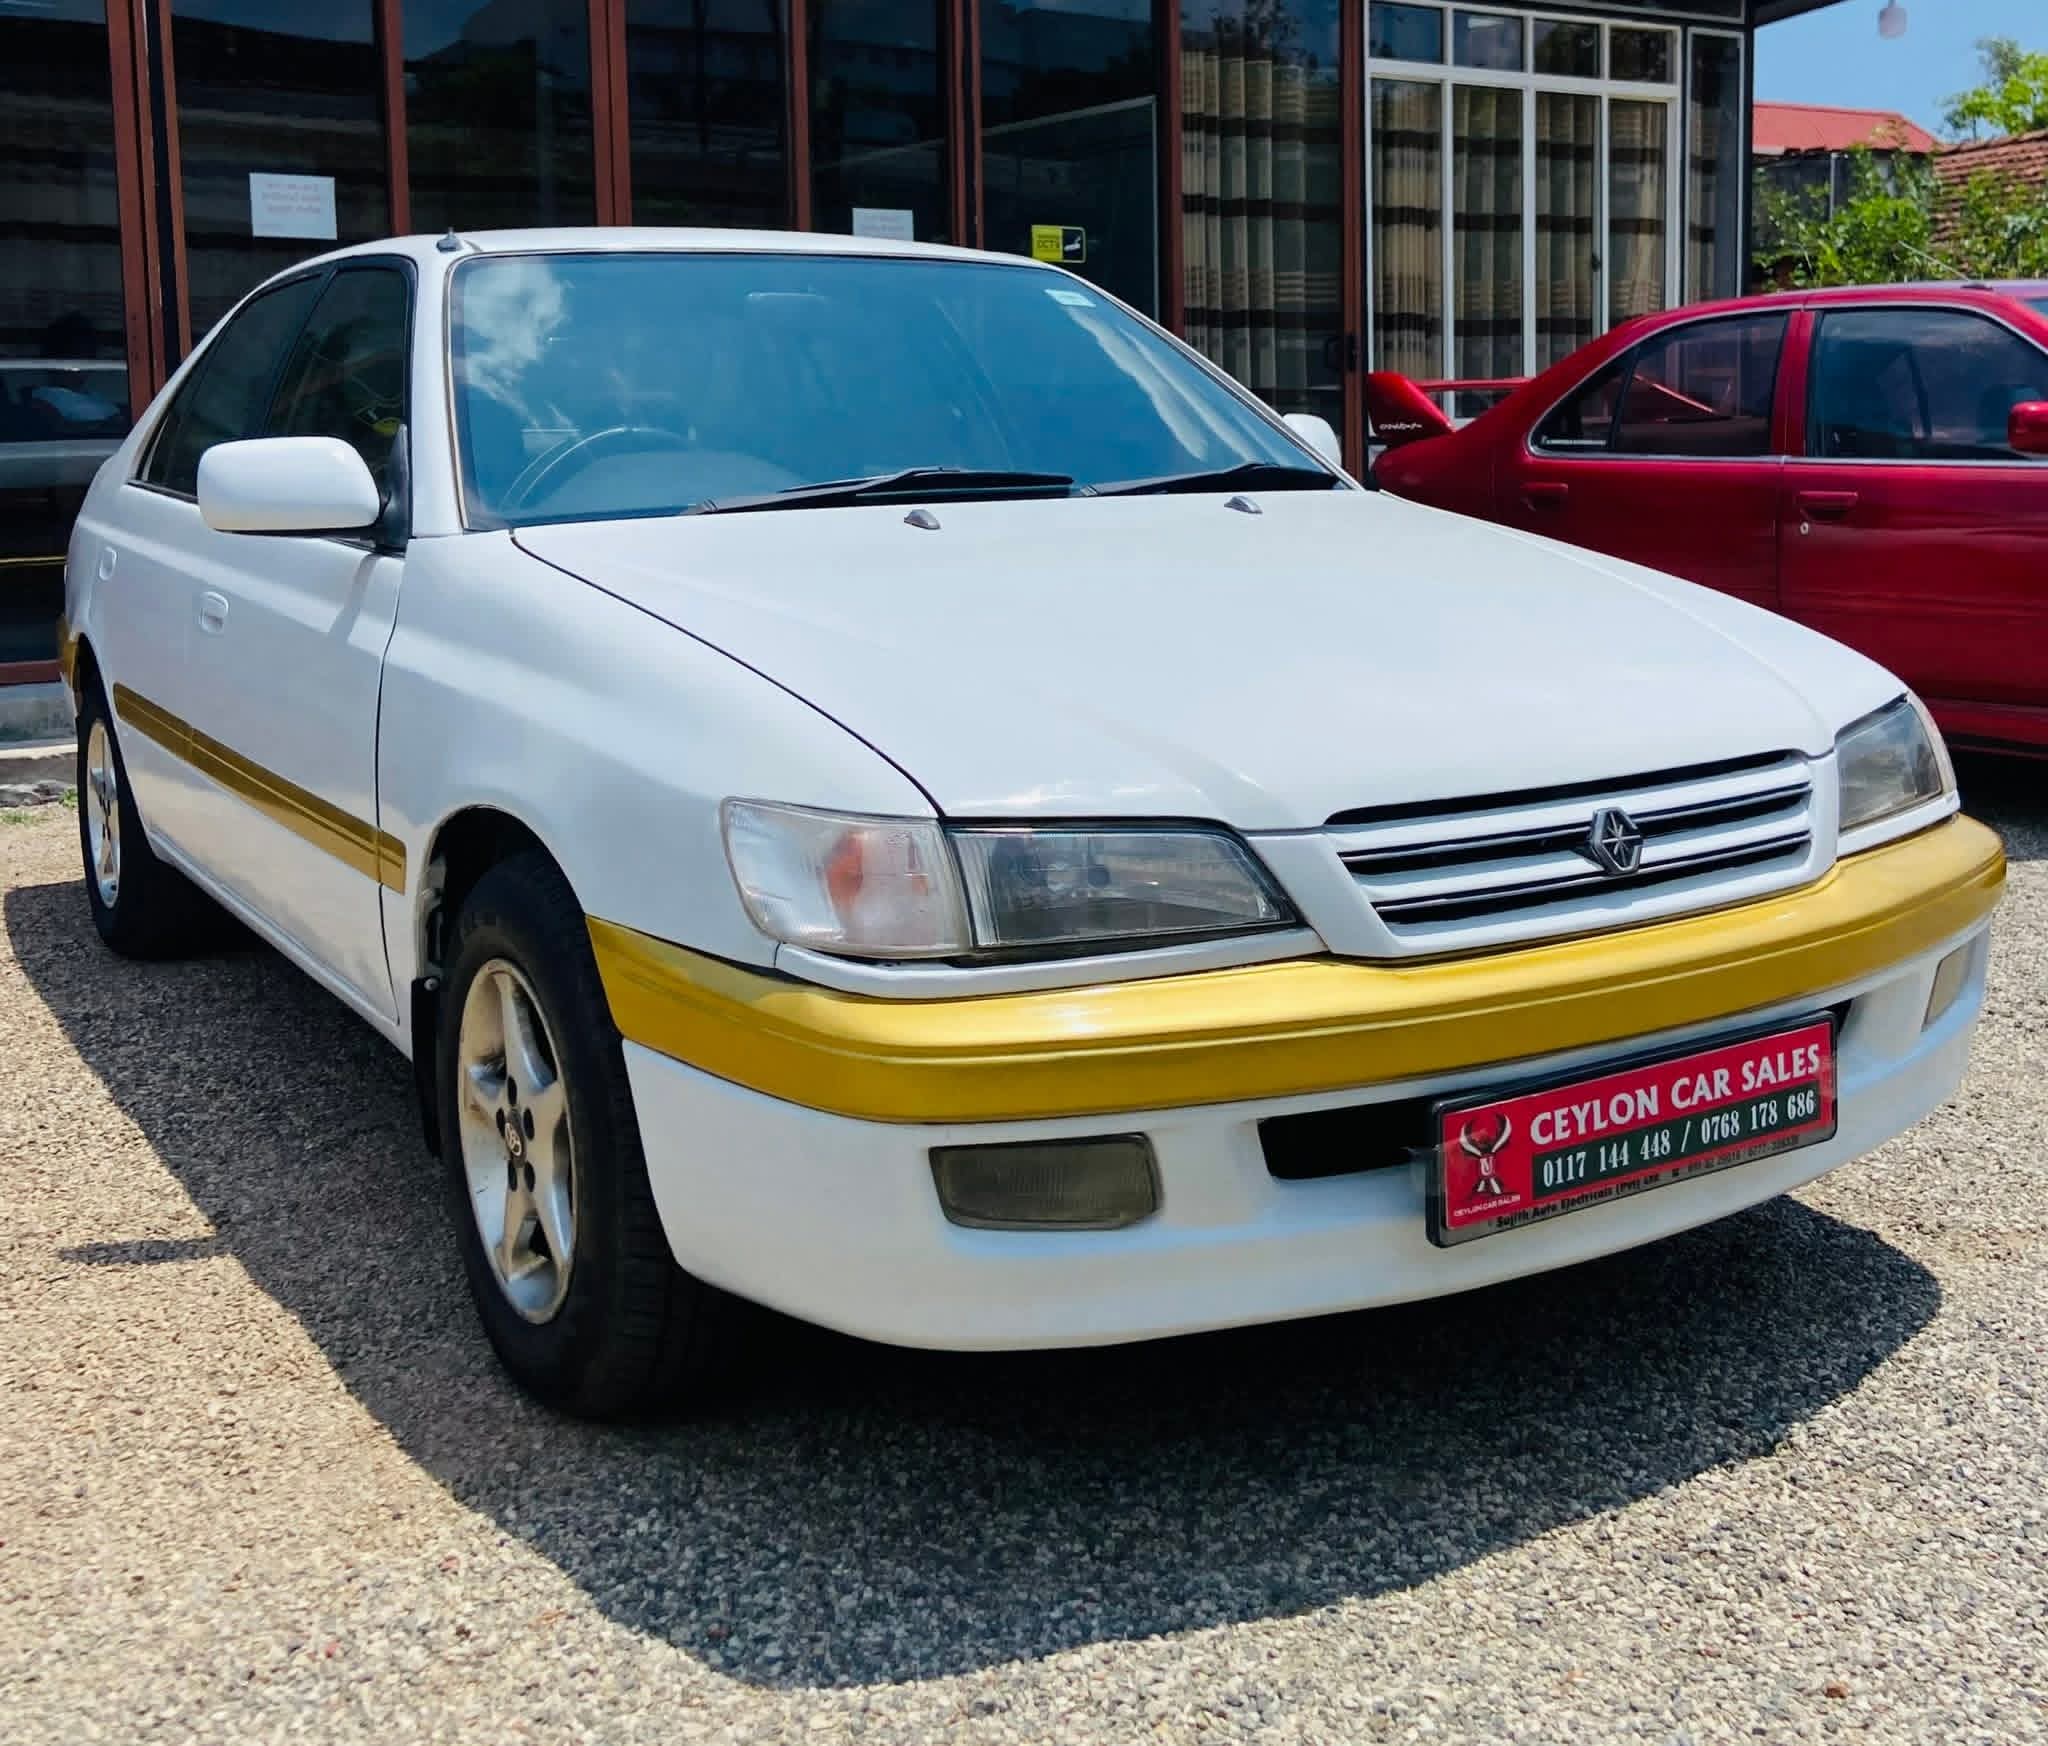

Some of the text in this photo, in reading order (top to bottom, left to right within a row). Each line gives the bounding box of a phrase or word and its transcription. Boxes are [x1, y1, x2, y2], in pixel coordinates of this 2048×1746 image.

[1530, 1043, 1820, 1144] CEYLON CAR SALES
[1542, 1151, 1587, 1187] 0117
[1599, 1139, 1630, 1173] 144
[1639, 1129, 1671, 1162] 448
[1680, 1120, 1691, 1153] /
[1701, 1110, 1740, 1145] 0768
[1751, 1099, 1778, 1131] 178
[1786, 1089, 1815, 1121] 686
